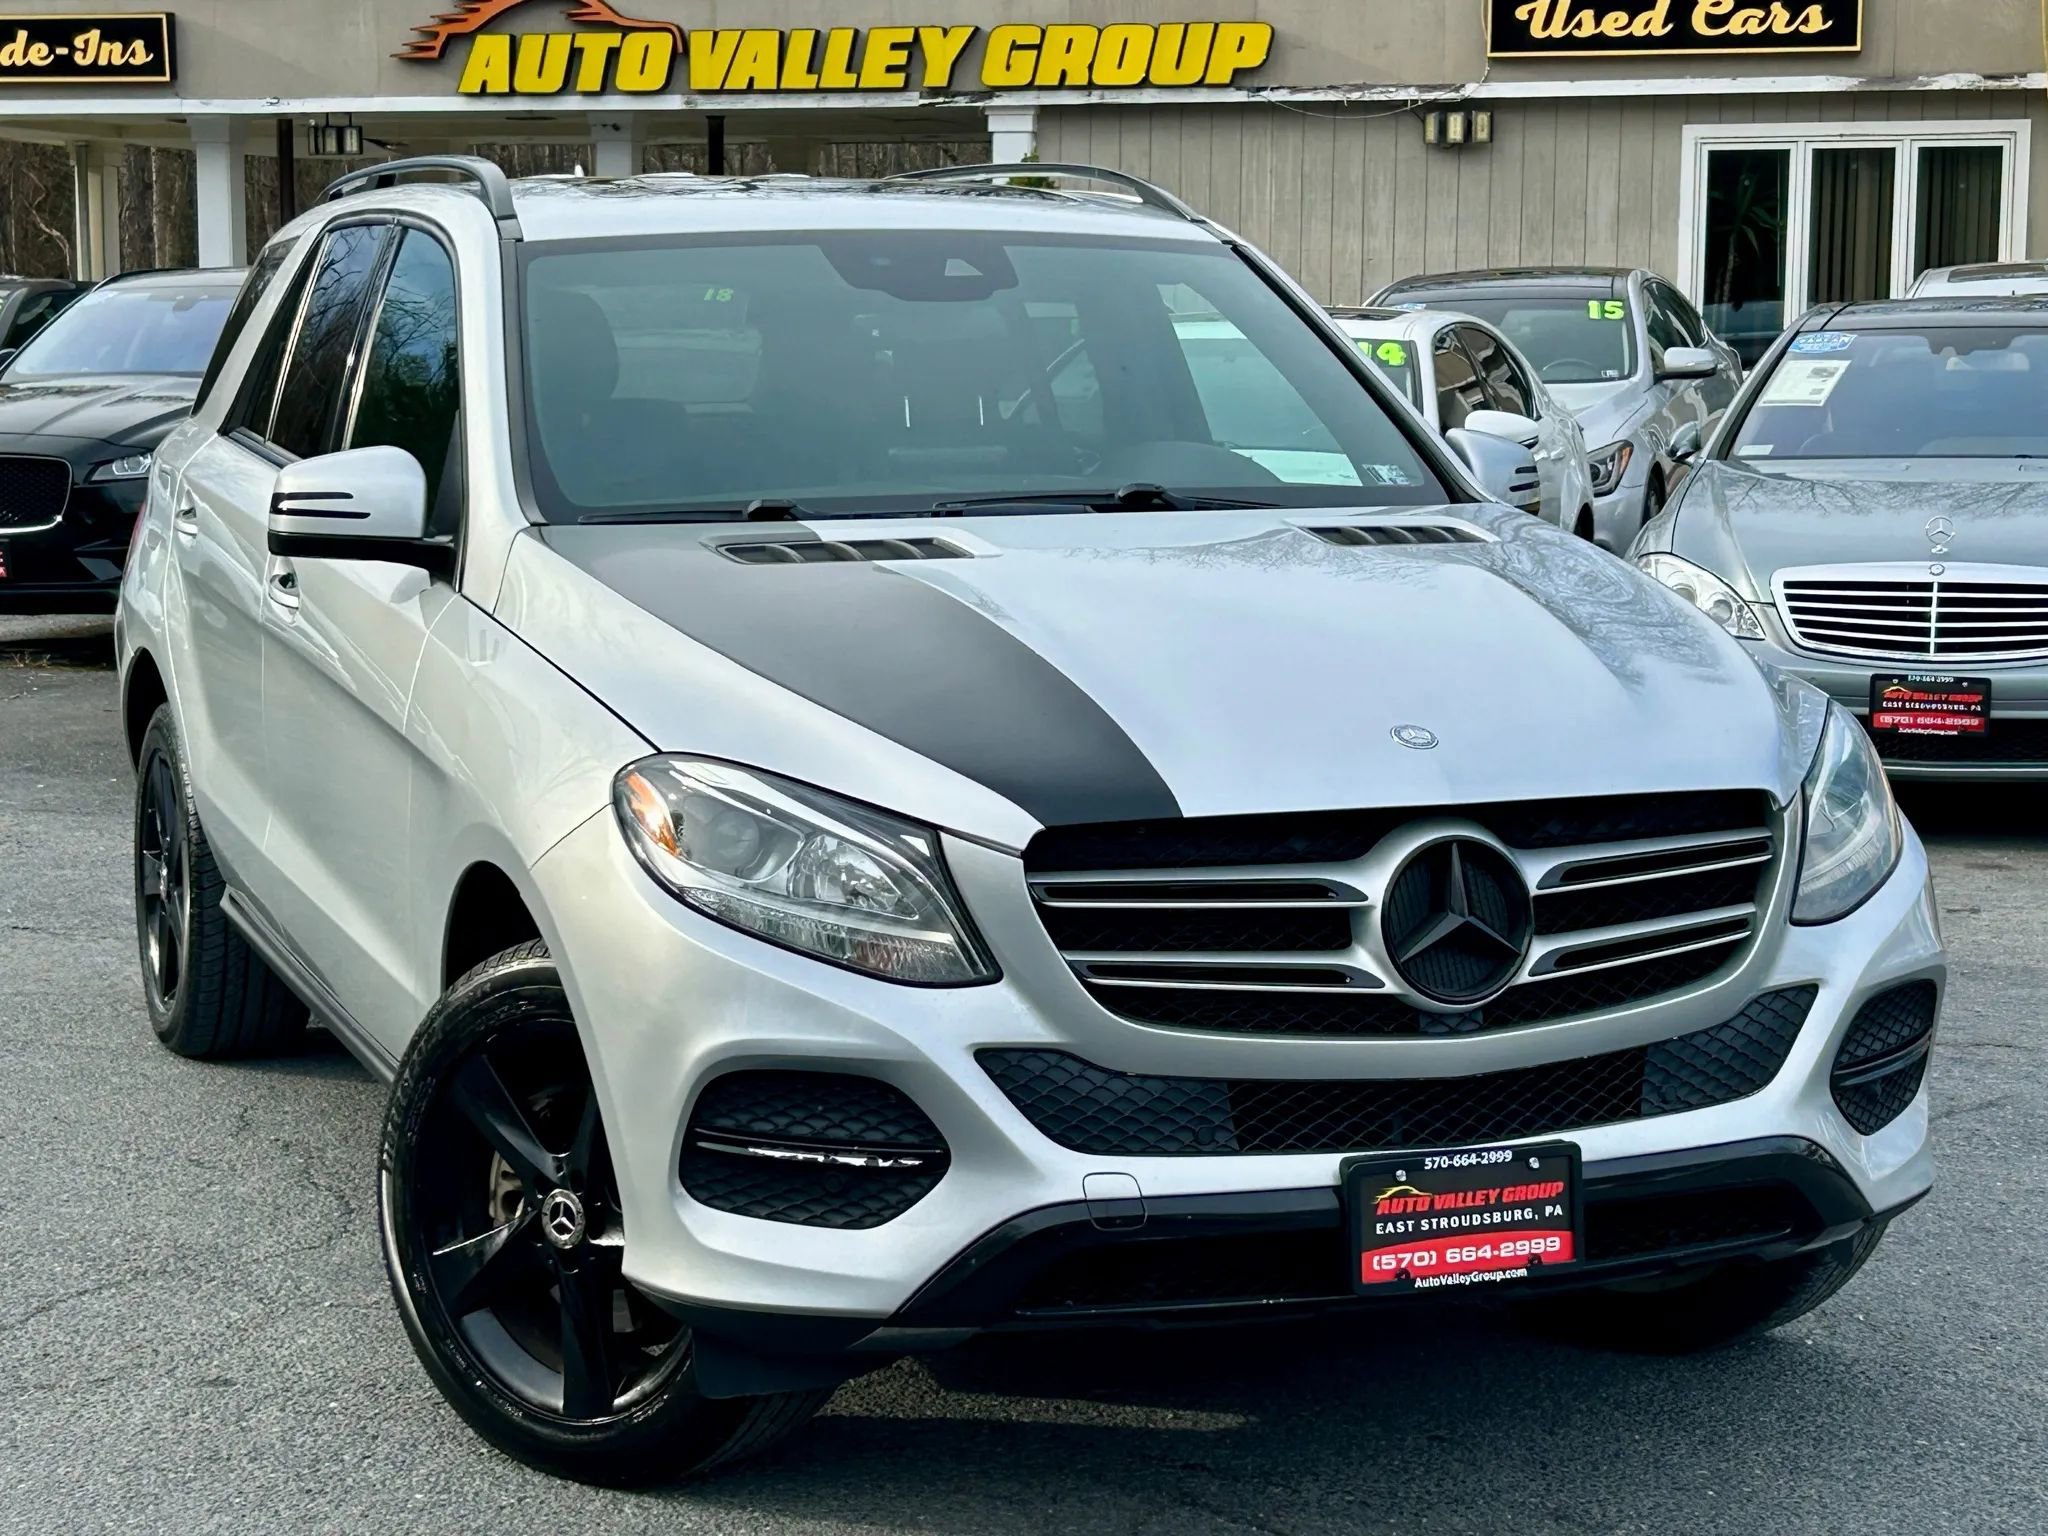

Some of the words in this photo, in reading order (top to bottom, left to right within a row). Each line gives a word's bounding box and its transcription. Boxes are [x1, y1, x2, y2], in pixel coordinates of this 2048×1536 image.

[1514, 0, 1676, 39] Used
[1690, 0, 1834, 36] Cars
[457, 33, 674, 95] AUTO
[688, 26, 980, 91] VALLEY
[981, 22, 1273, 88] GROUP
[1588, 299, 1625, 320] 15
[1423, 1150, 1513, 1170] 570-664-2999
[1376, 1194, 1432, 1216] AUTO
[1432, 1188, 1501, 1210] VALLEY
[1501, 1180, 1565, 1204] GROUP
[1375, 1220, 1415, 1235] EAST
[1420, 1207, 1540, 1231] STROUDSBURG,
[1544, 1204, 1564, 1218] PA
[1372, 1251, 1437, 1271] (570)
[1445, 1236, 1561, 1263] 664-2999
[1414, 1266, 1528, 1289] AutoValleyGroup.com
